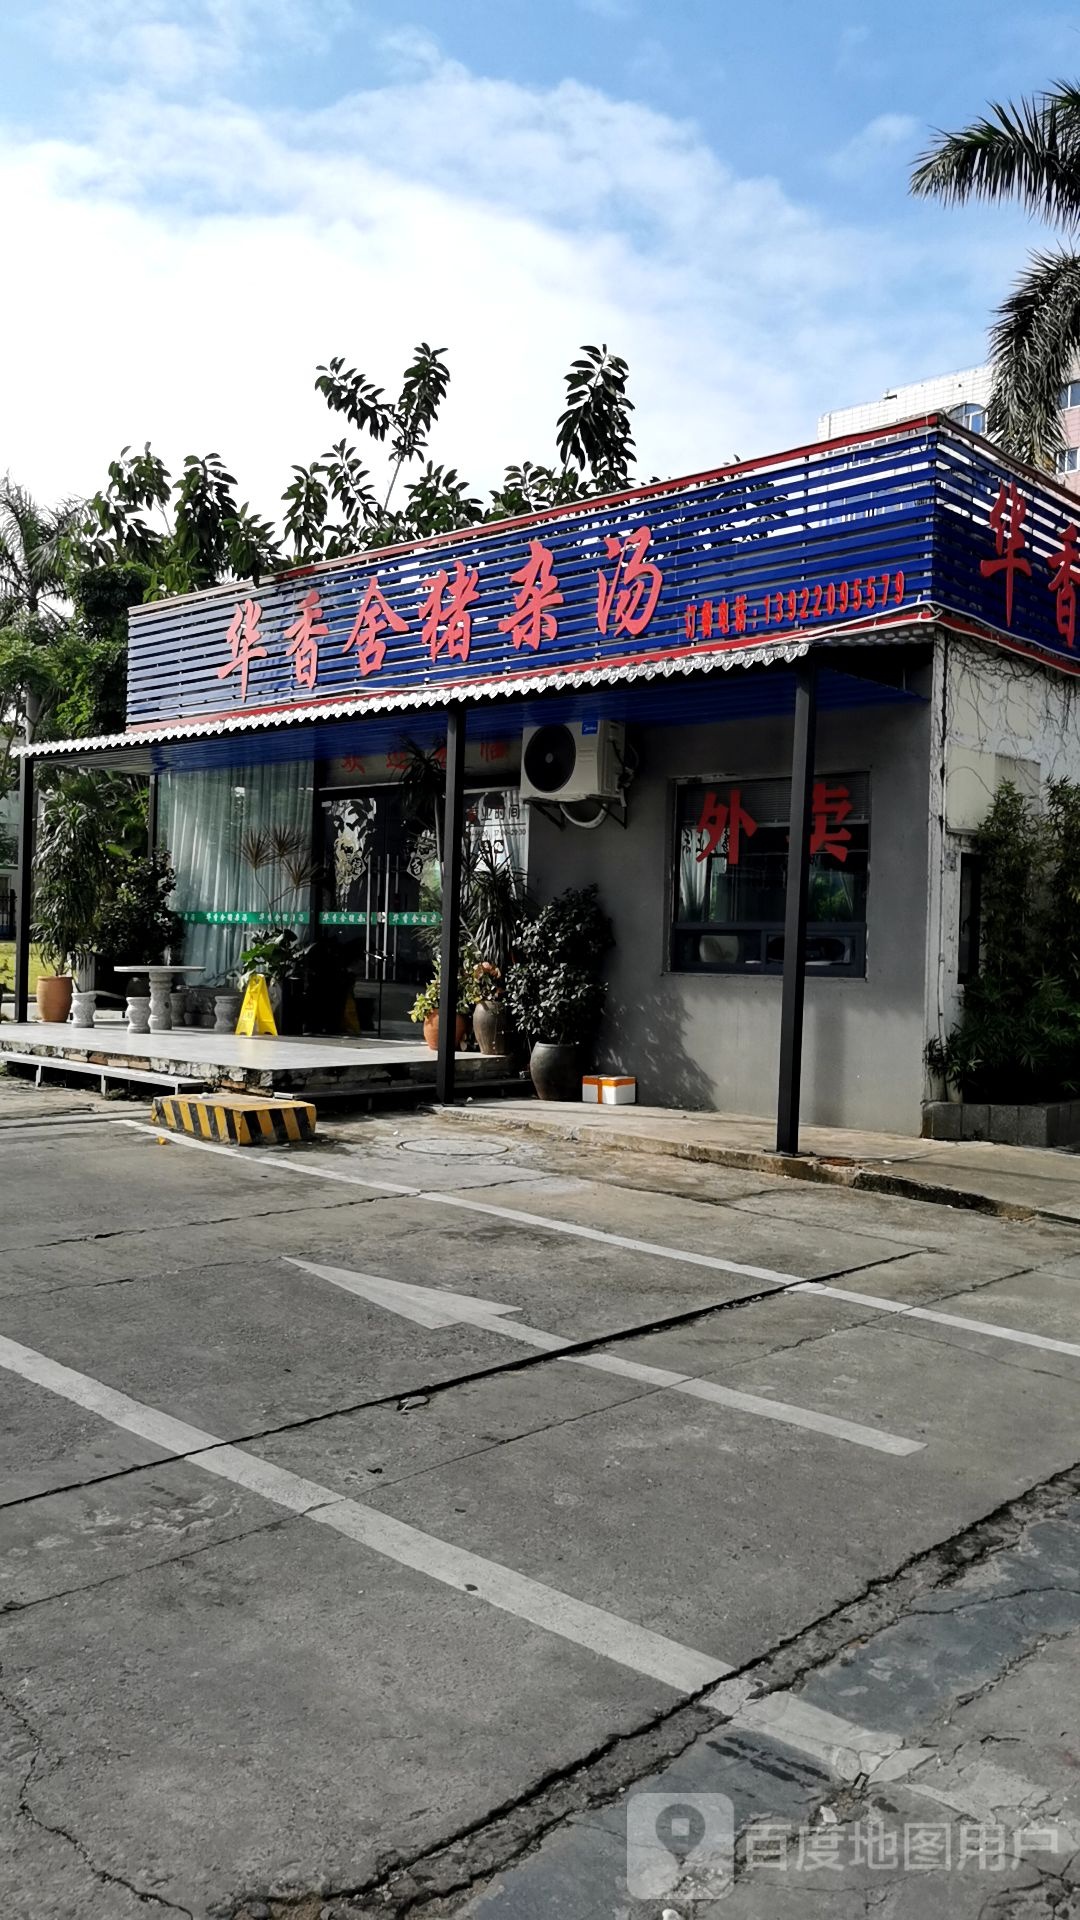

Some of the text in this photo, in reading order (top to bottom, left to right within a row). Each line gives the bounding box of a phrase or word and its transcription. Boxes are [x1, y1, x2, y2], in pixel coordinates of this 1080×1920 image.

[217, 525, 663, 702] 华香舍猪杂汤
[696, 782, 855, 865] 外卖
